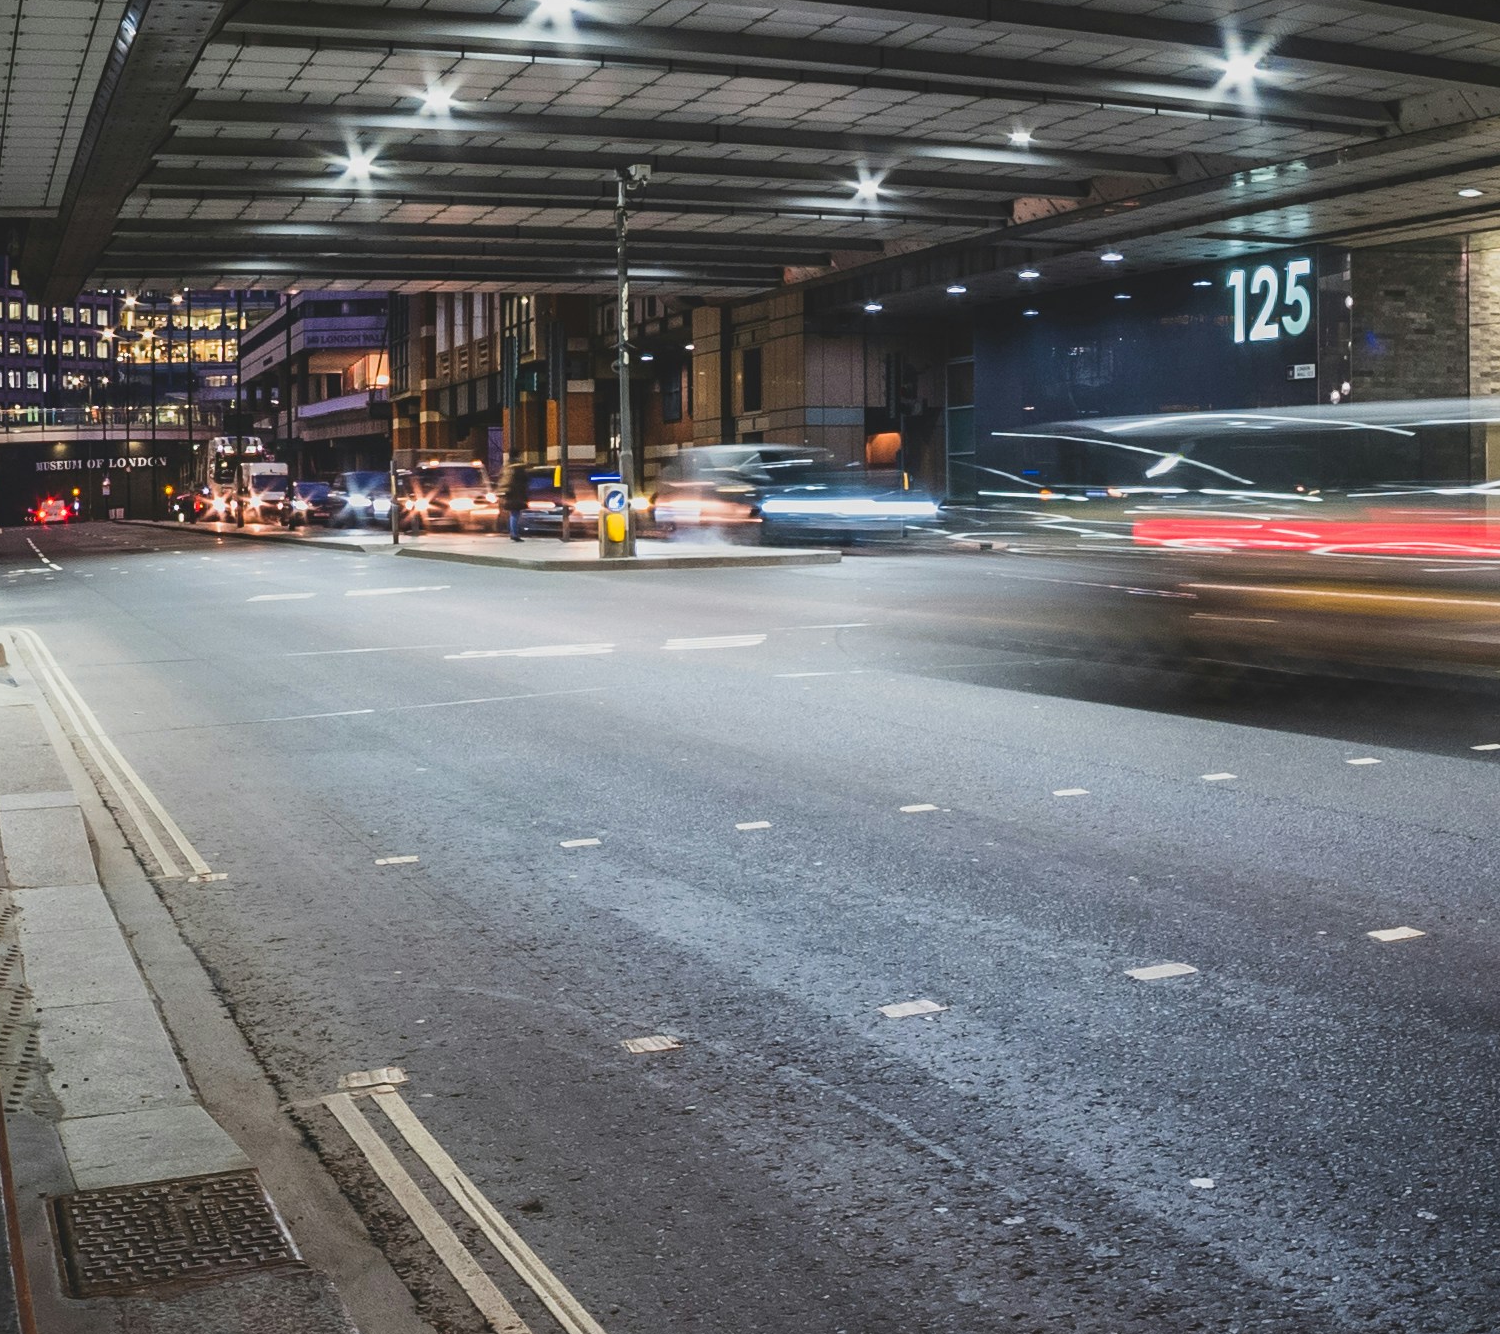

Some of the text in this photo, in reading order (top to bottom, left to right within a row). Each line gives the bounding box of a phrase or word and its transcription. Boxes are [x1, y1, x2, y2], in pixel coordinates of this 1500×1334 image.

[1226, 258, 1311, 343] 125
[36, 457, 167, 471] MUSEUM OF LONDON
